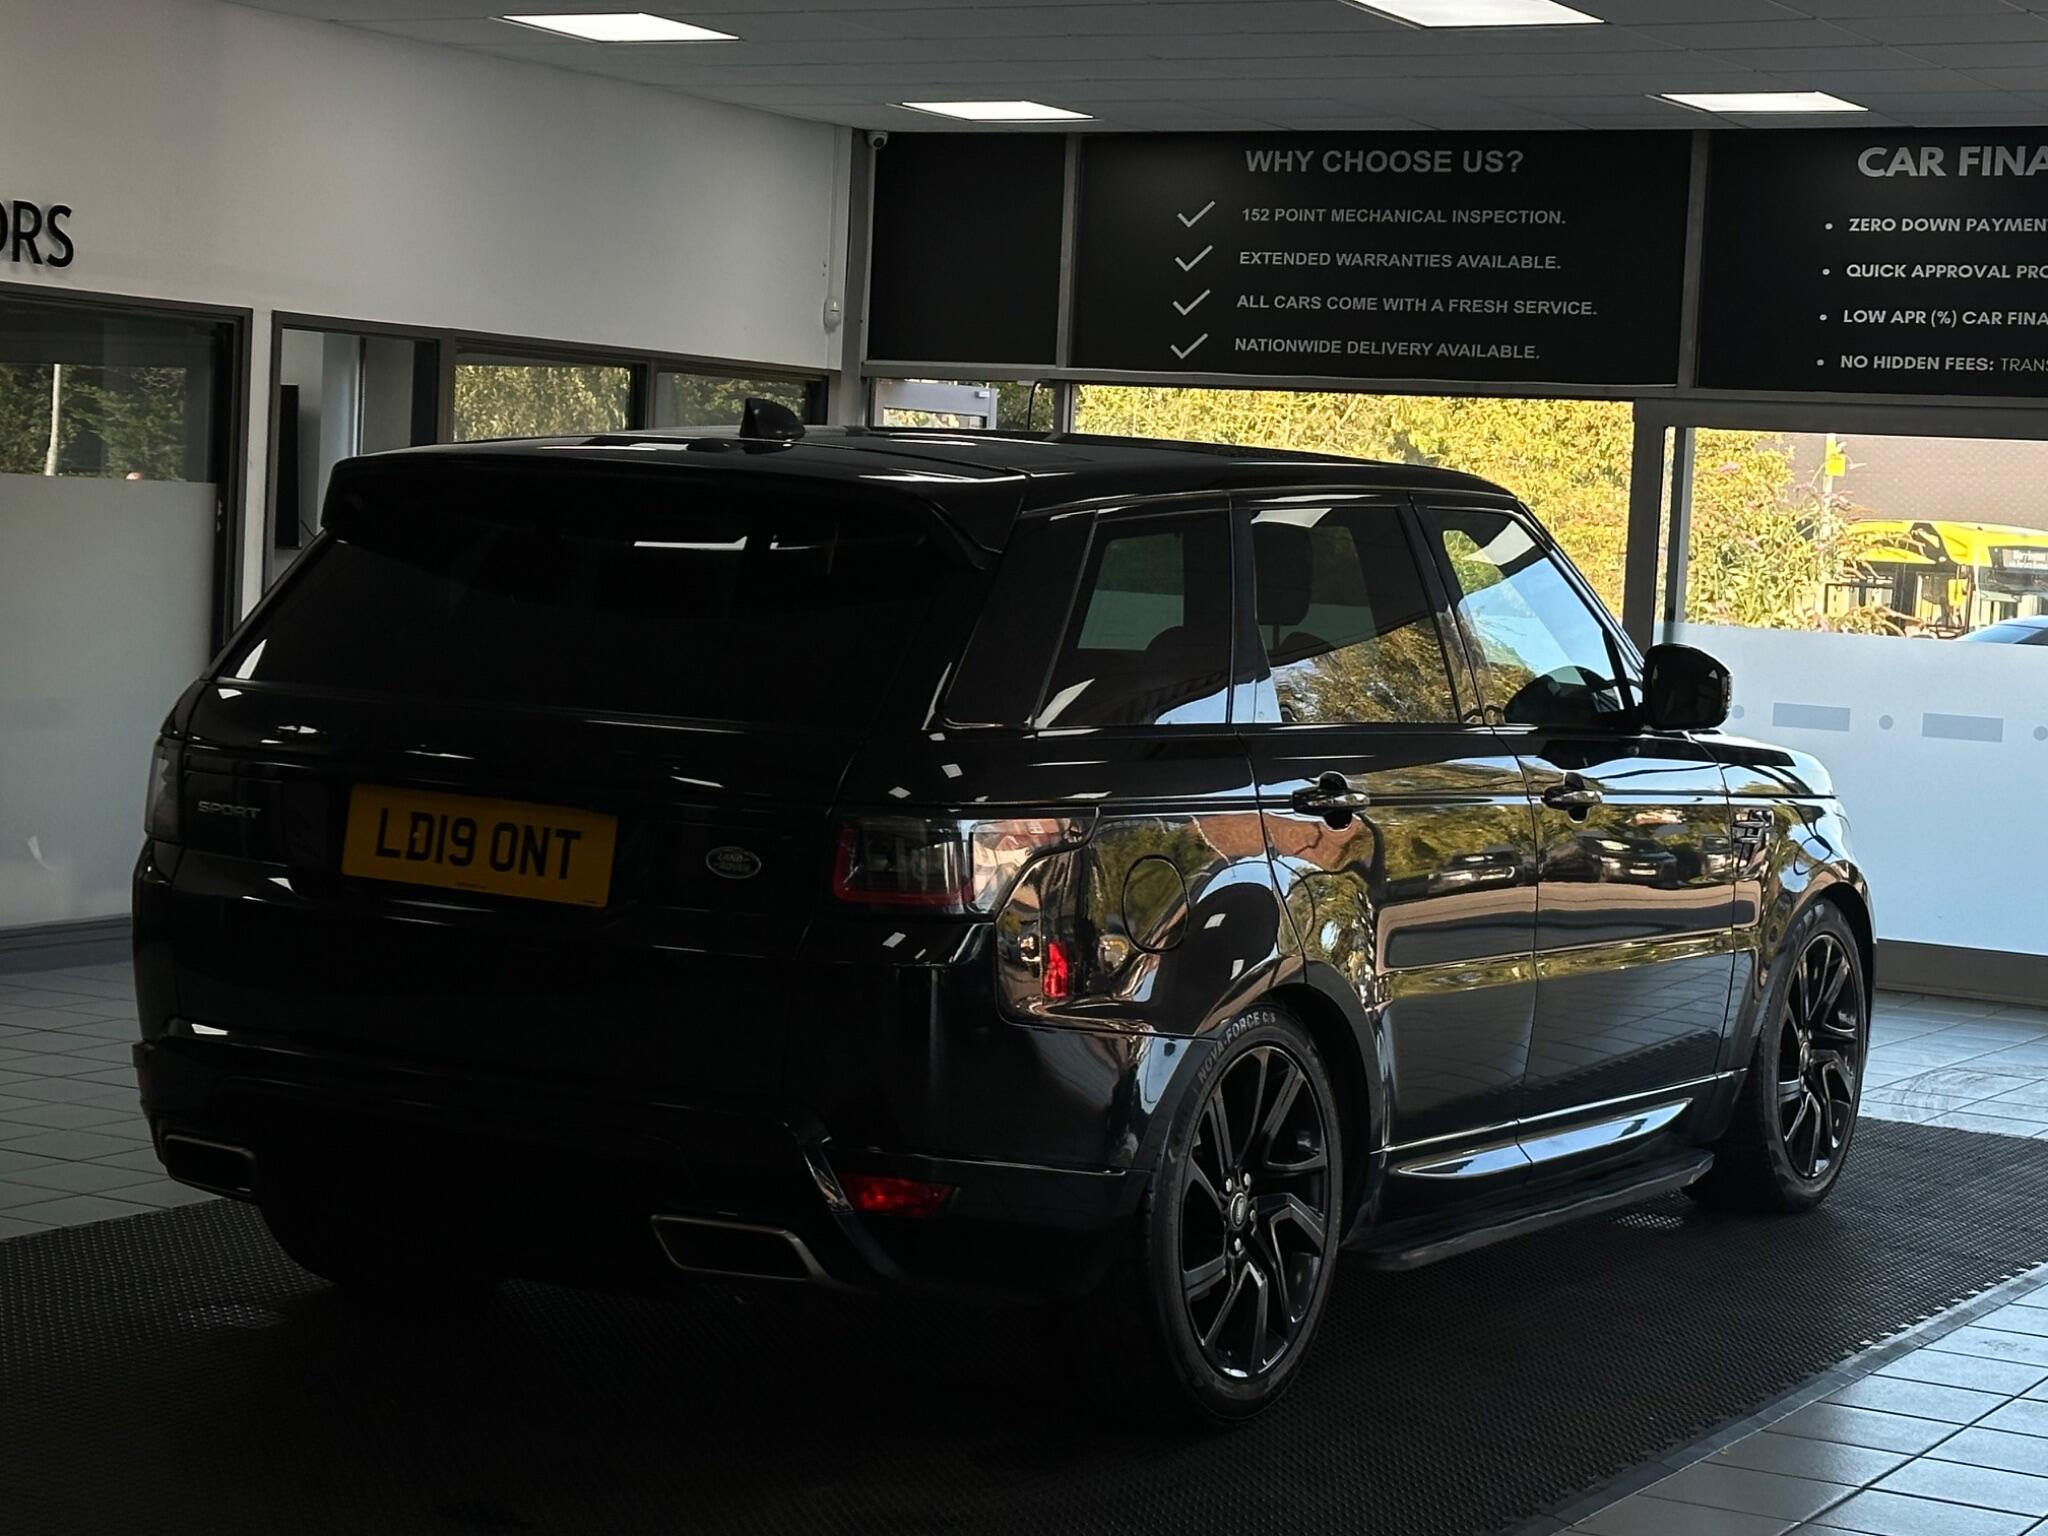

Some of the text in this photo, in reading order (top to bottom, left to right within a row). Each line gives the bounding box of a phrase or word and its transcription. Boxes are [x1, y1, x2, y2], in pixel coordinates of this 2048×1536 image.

[1245, 149, 1524, 174] WHY CHOOSE US?
[1857, 146, 1947, 178] CAR
[1241, 207, 1566, 225] 152 POINT MECHANICAL INSPECTION.
[1848, 217, 2048, 233] ZERO DOWN PAYMEN
[0, 199, 75, 268] RS
[1239, 251, 1561, 270] EXTENDED WARRANTIES AVAILABLE.
[1846, 263, 1907, 278] QUICK
[1910, 264, 2011, 279] APPROVAL
[1236, 294, 1598, 316] ALL CARS COME WITH A FRESH SERVICE.
[1843, 309, 1887, 324] LOW
[1890, 310, 1927, 325] APR
[1930, 309, 1957, 328] (%)
[1961, 311, 2003, 326] CAR
[1234, 337, 1541, 360] NATIONWIDE DELIVERY AVAILABLE.
[1840, 354, 1869, 369] NO
[1873, 355, 1940, 370] HIDDEN
[1944, 356, 1994, 371] FEES:
[198, 800, 261, 820] SPORT
[375, 807, 583, 880] LD19 ONT
